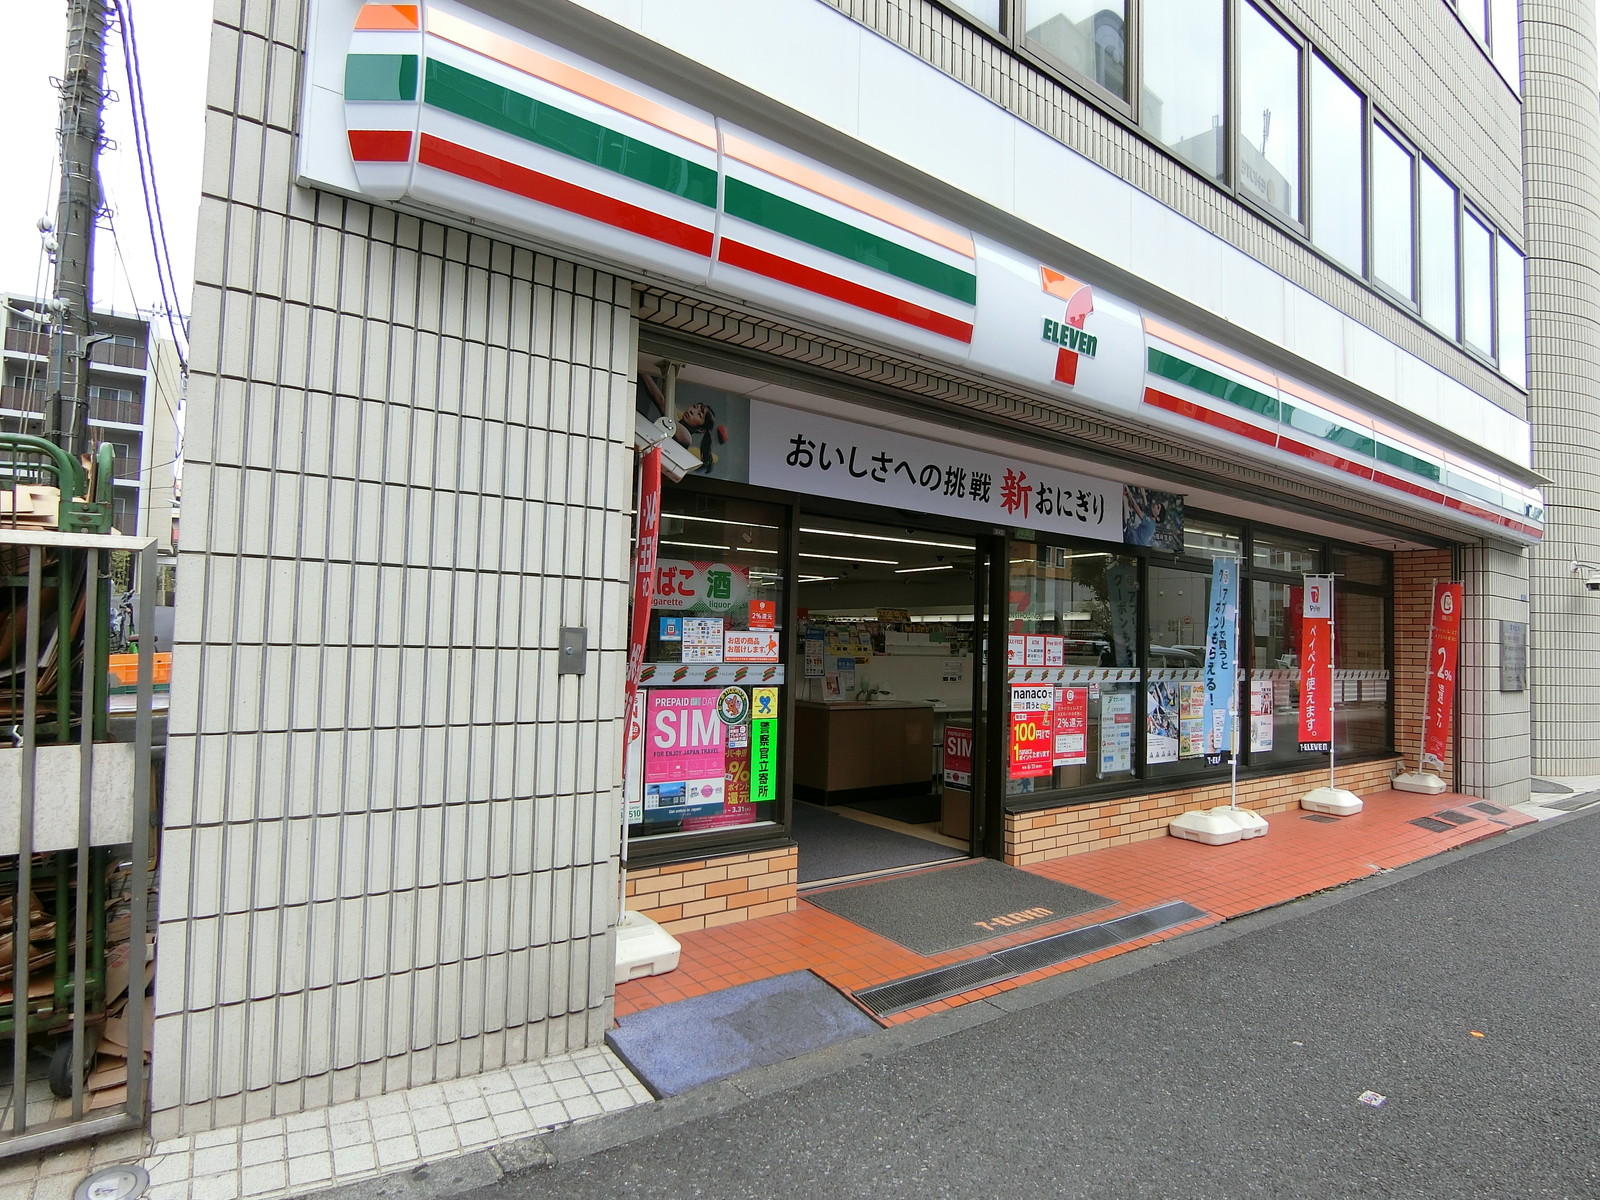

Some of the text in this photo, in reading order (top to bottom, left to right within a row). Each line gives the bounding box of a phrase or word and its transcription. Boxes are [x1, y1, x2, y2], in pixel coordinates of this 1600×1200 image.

[786, 433, 992, 503] おいしさへの挑戦
[651, 565, 732, 599] ばこ 酒
[709, 600, 732, 610] liquor
[727, 637, 760, 645] お店の商品
[1218, 588, 1229, 670] アプリで買うと
[1305, 624, 1317, 737] ペイペイ使えます。
[655, 697, 689, 707] PREPAID
[702, 696, 718, 706] DAT
[653, 708, 721, 749] SIM
[1057, 717, 1084, 728] 2%還元
[757, 721, 770, 798] 警察官立寄所
[727, 783, 750, 794] ポイント
[727, 791, 750, 805] 還元
